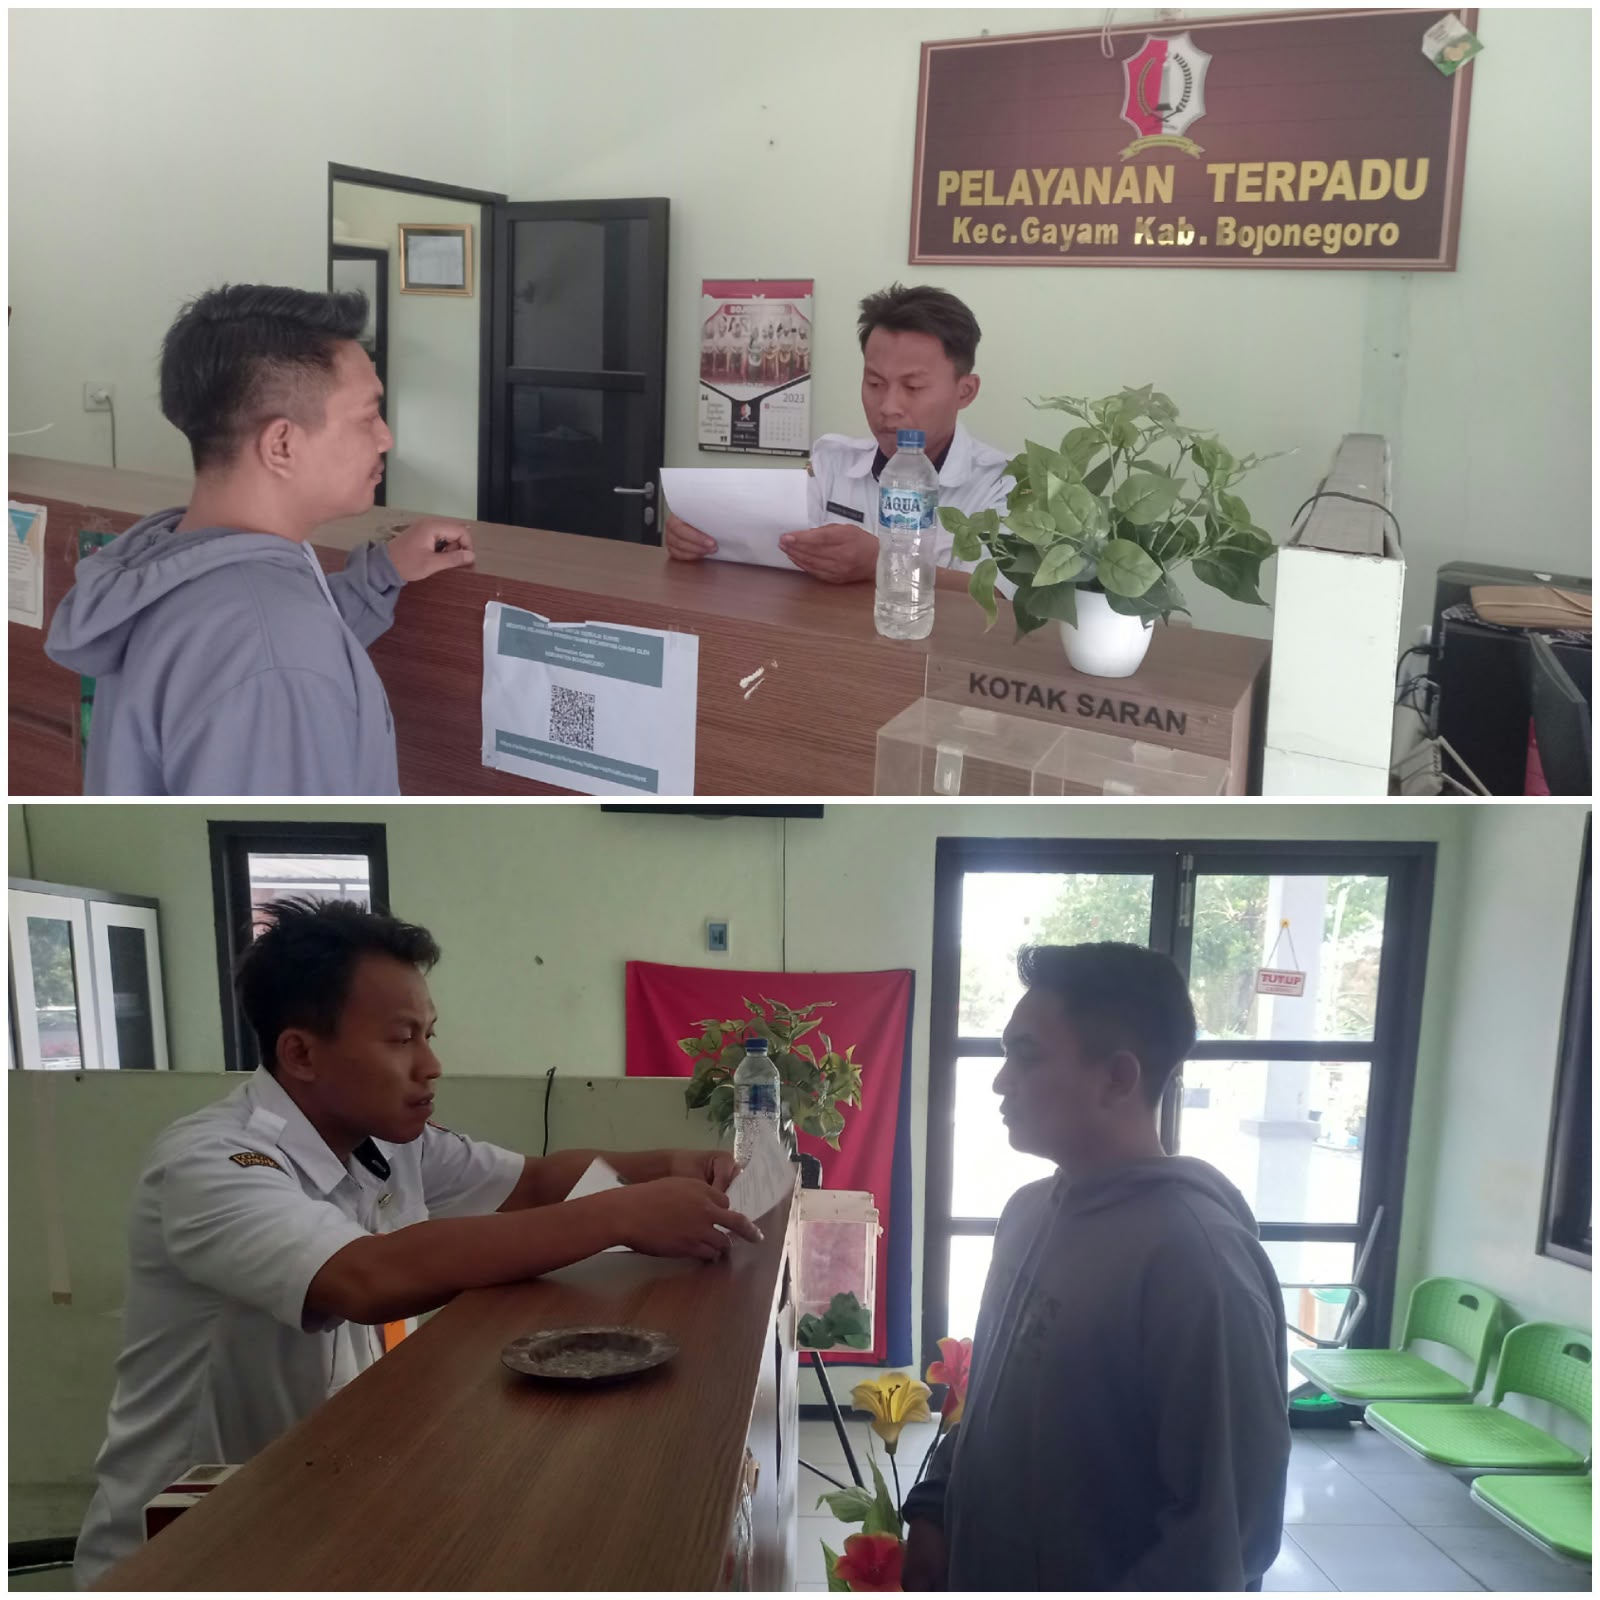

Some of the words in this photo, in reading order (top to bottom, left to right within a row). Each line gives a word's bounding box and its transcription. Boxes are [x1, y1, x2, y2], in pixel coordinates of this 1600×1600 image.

[937, 163, 1177, 207] PELAYANAN
[1207, 157, 1429, 205] TERPADU
[1214, 215, 1401, 256] Bojonegoro
[783, 393, 805, 403] 2023
[884, 496, 921, 514] AQUA
[969, 672, 1068, 714] KOTAK
[1076, 692, 1188, 736] SARAN
[1261, 974, 1302, 985] TUTUP
